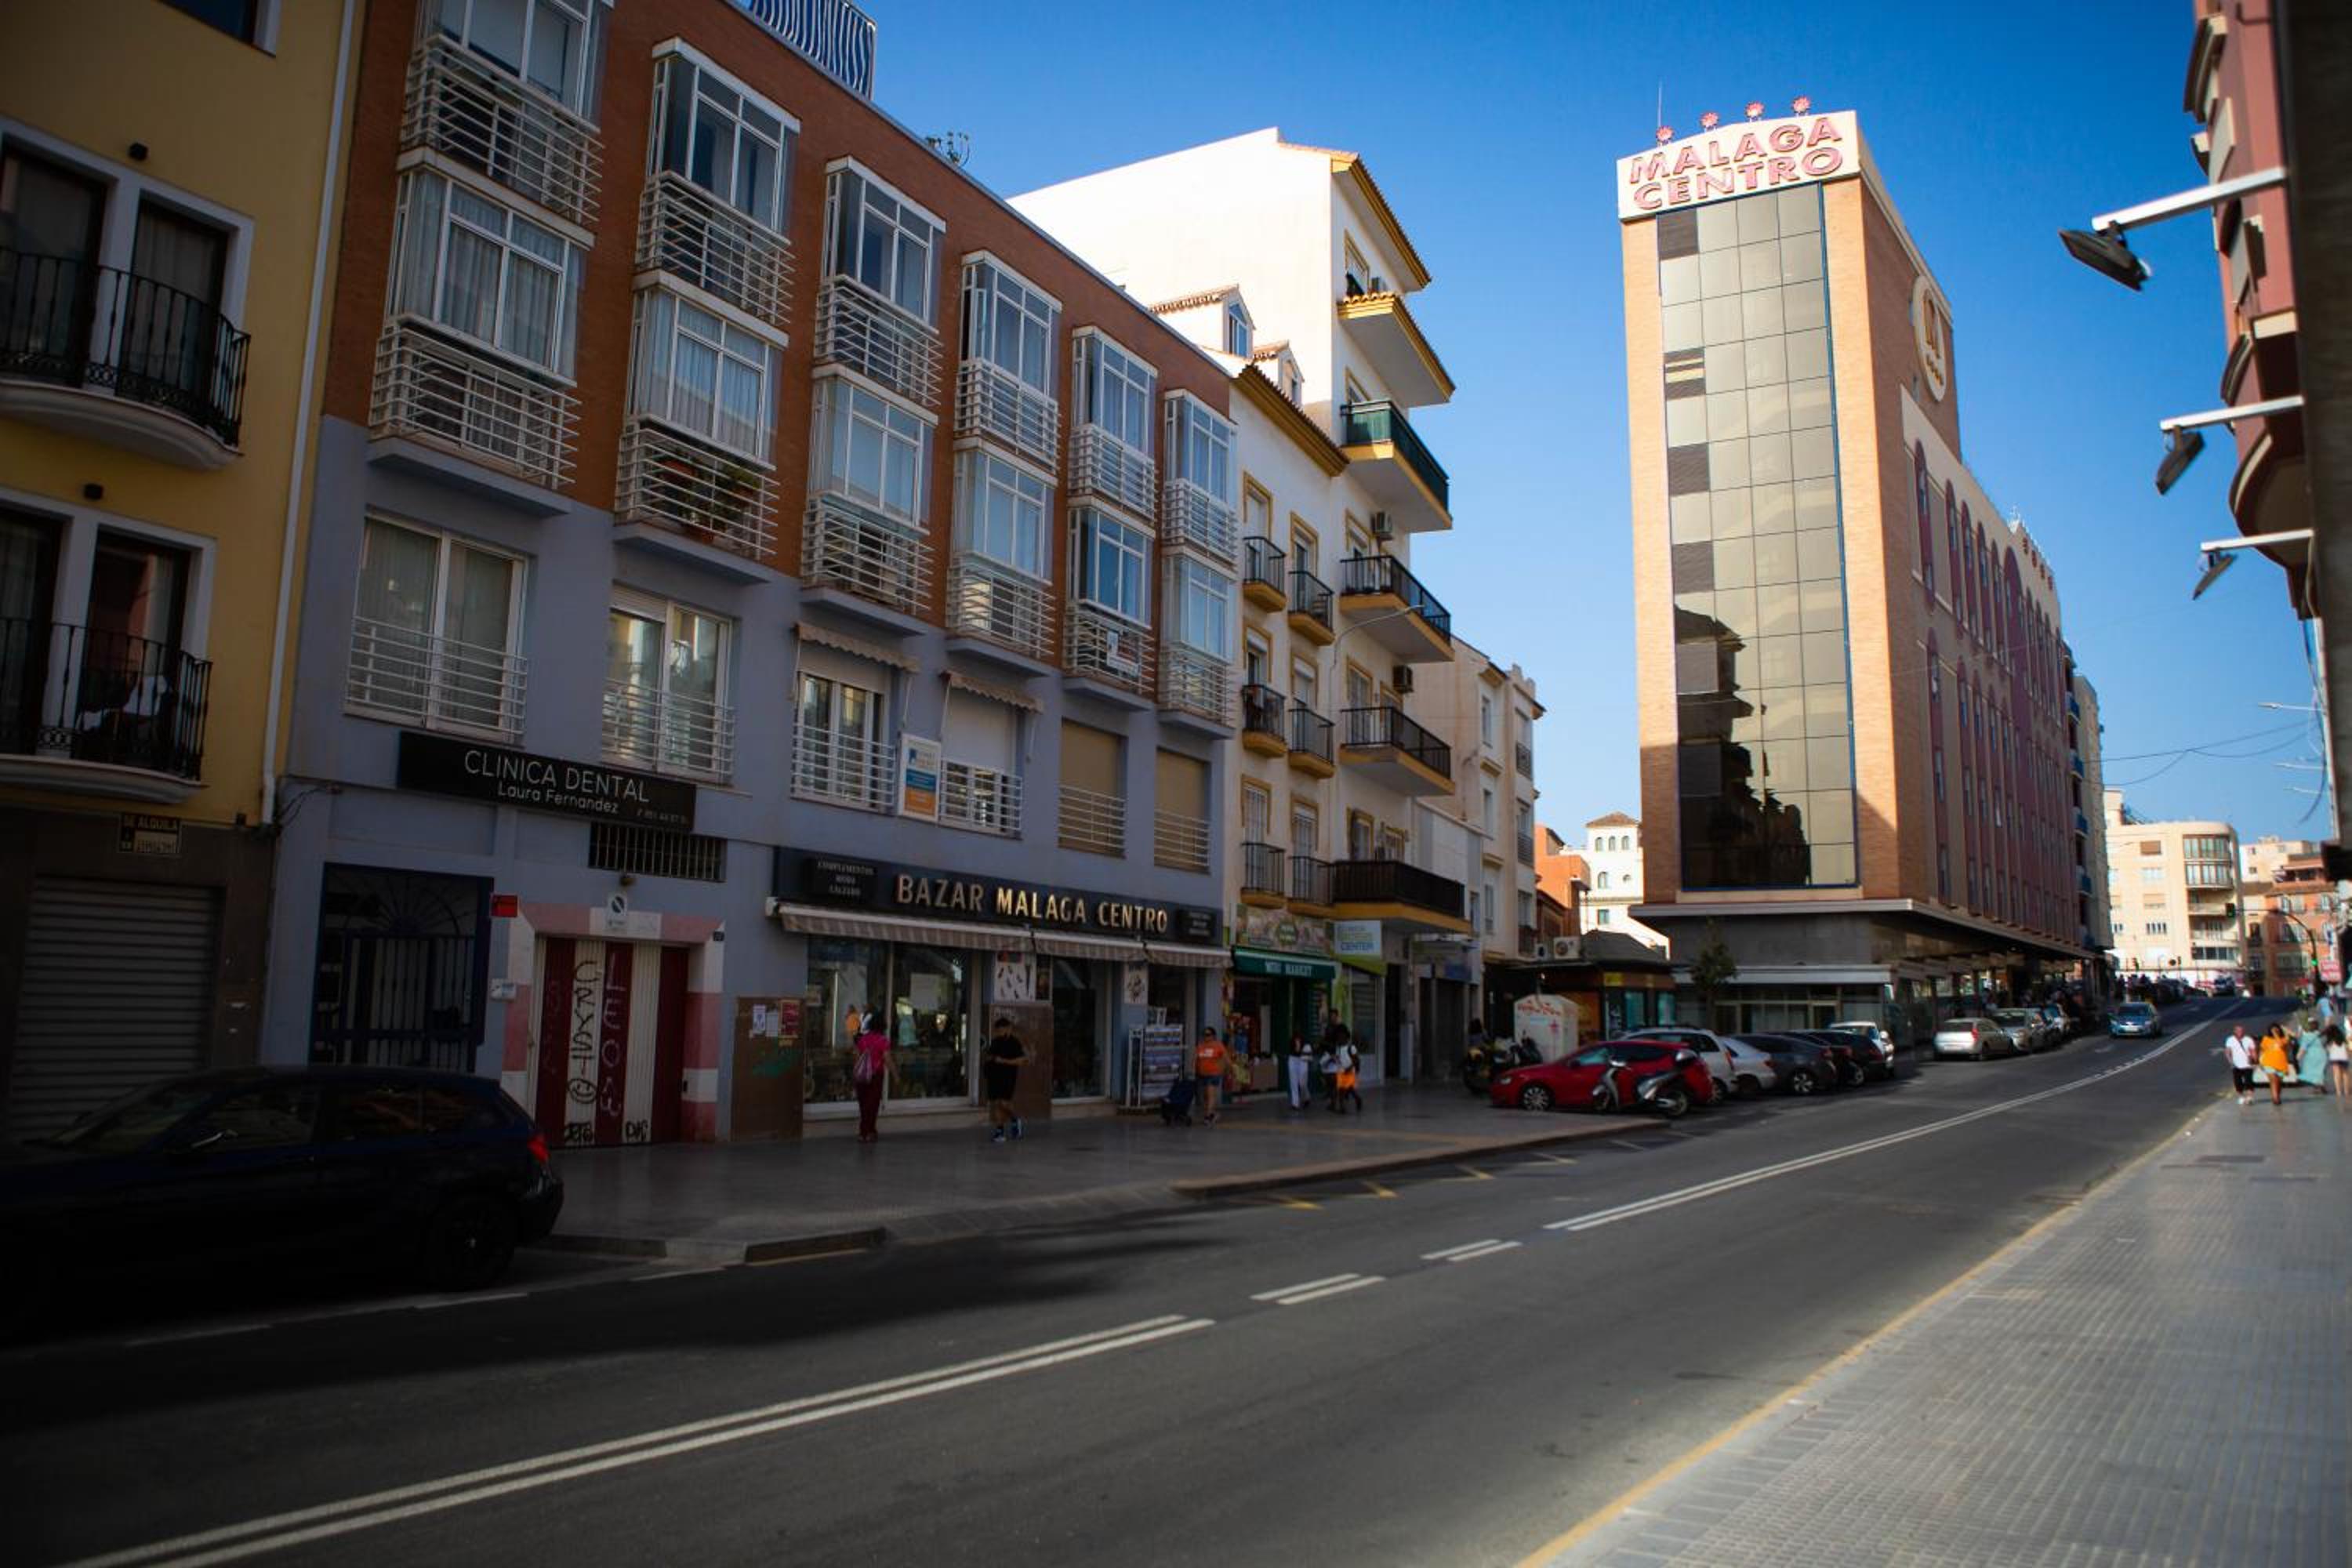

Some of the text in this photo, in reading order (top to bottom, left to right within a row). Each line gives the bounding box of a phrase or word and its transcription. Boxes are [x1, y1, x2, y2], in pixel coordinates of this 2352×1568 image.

[1629, 118, 1842, 184] MALAGA
[1634, 147, 1843, 210] CENTRO
[464, 750, 650, 803] CLINICA DENTAL
[498, 780, 619, 815] Laura Fernandez
[137, 815, 177, 829] ALQUILA
[897, 873, 985, 913] BAZAR
[996, 886, 1087, 924] MALAGA
[1098, 901, 1168, 934] CENTRO
